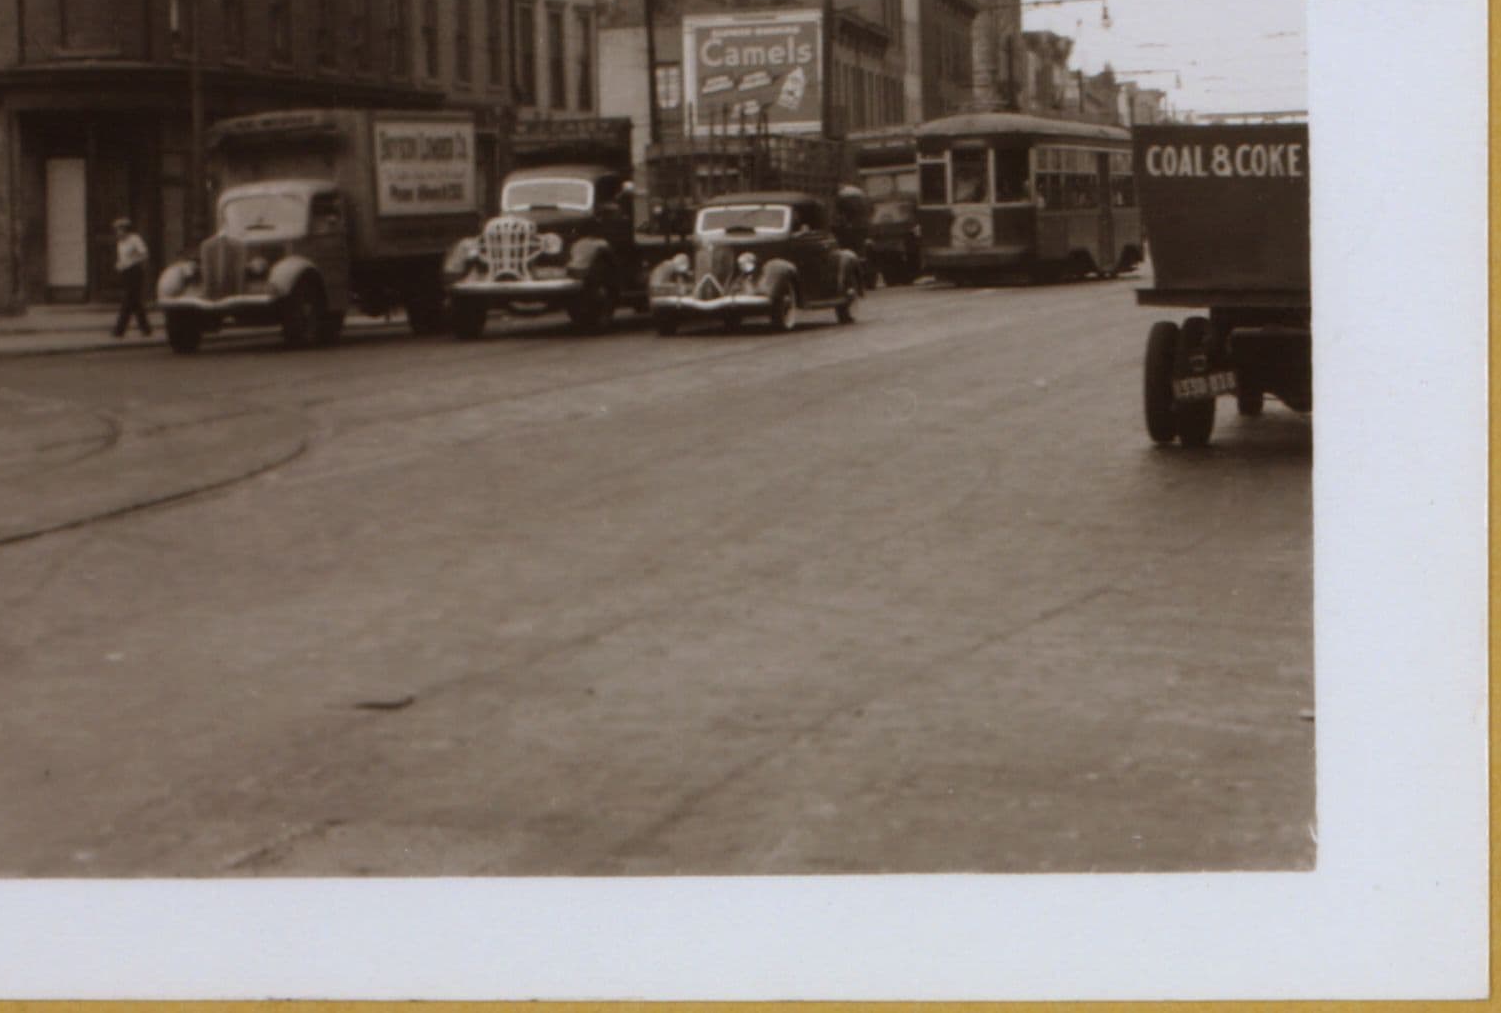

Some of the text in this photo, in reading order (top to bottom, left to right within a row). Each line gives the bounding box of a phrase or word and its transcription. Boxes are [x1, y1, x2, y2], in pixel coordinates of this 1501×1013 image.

[701, 36, 812, 67] Camels
[1146, 143, 1302, 177] COAL & COKE
